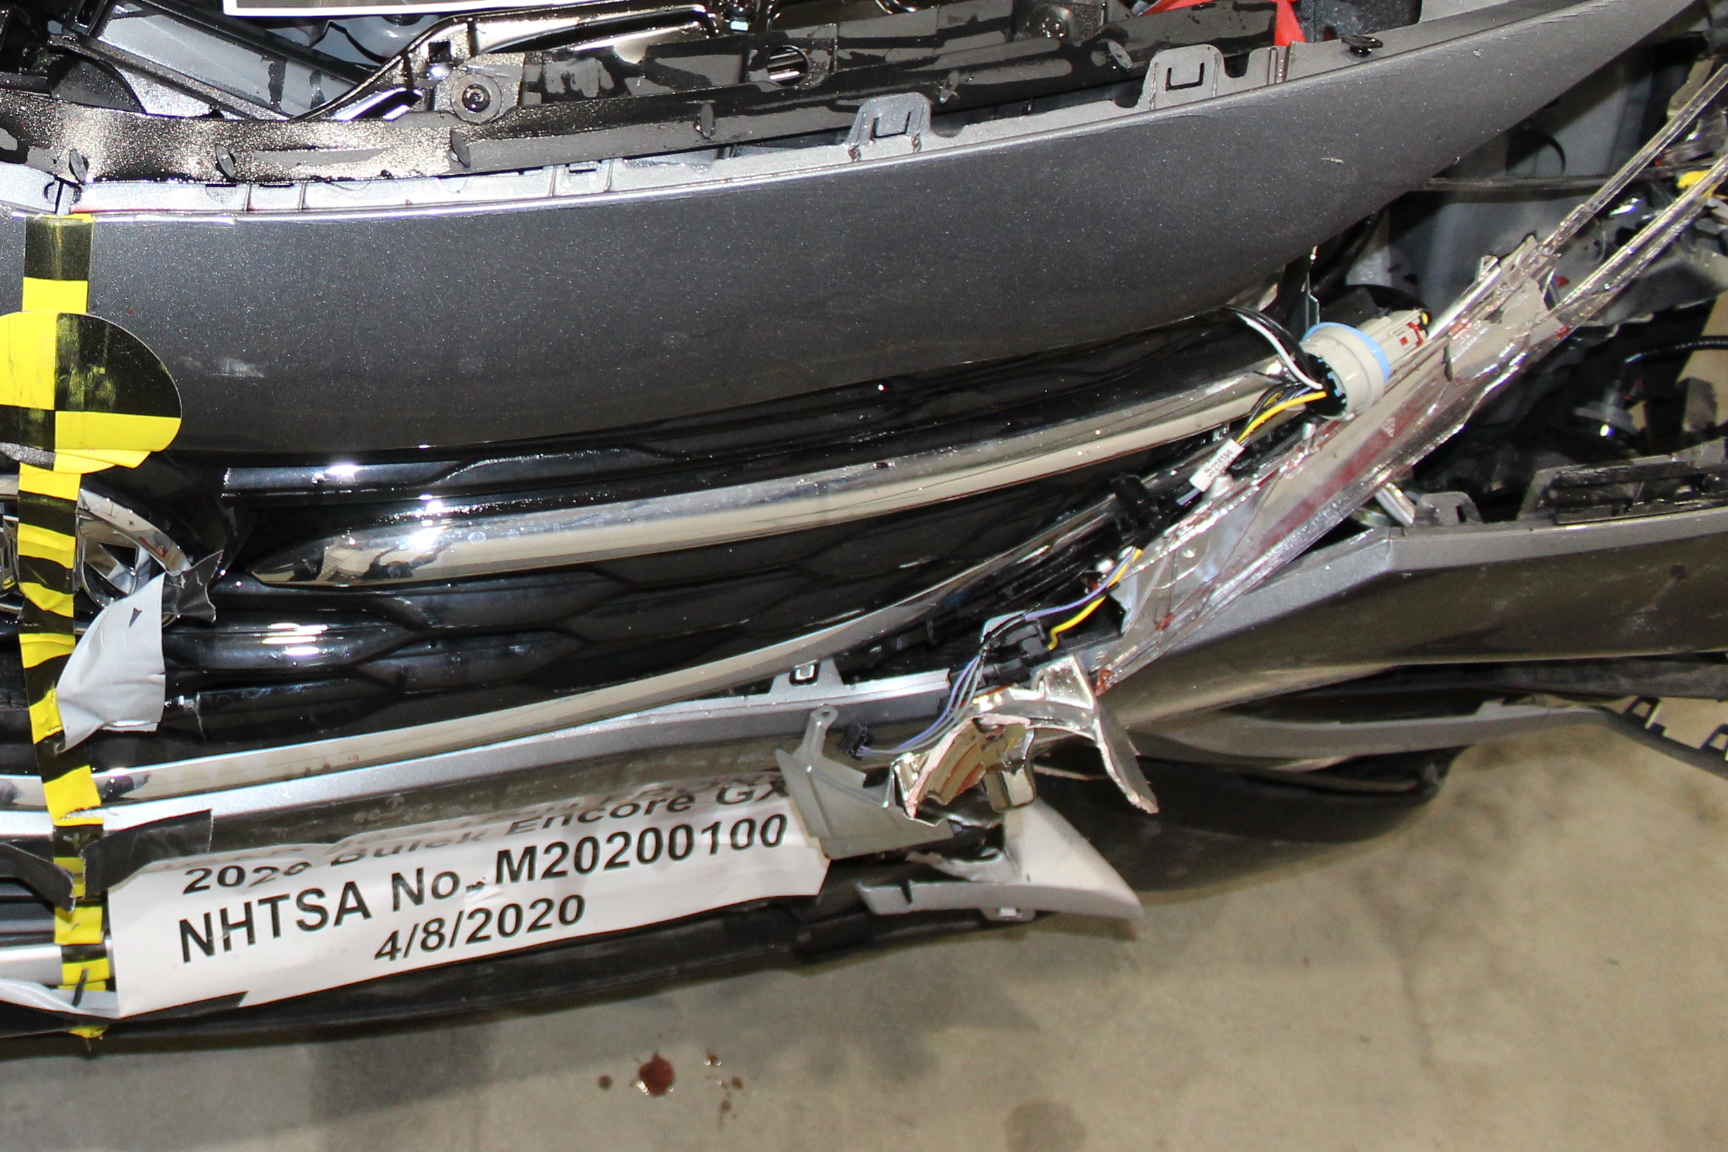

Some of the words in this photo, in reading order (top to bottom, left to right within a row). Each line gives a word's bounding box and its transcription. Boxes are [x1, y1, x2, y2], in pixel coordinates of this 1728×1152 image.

[182, 861, 314, 895] 2020
[505, 791, 697, 836] Encore
[178, 880, 373, 964] NHTSA
[374, 895, 587, 964] 4/8/2020
